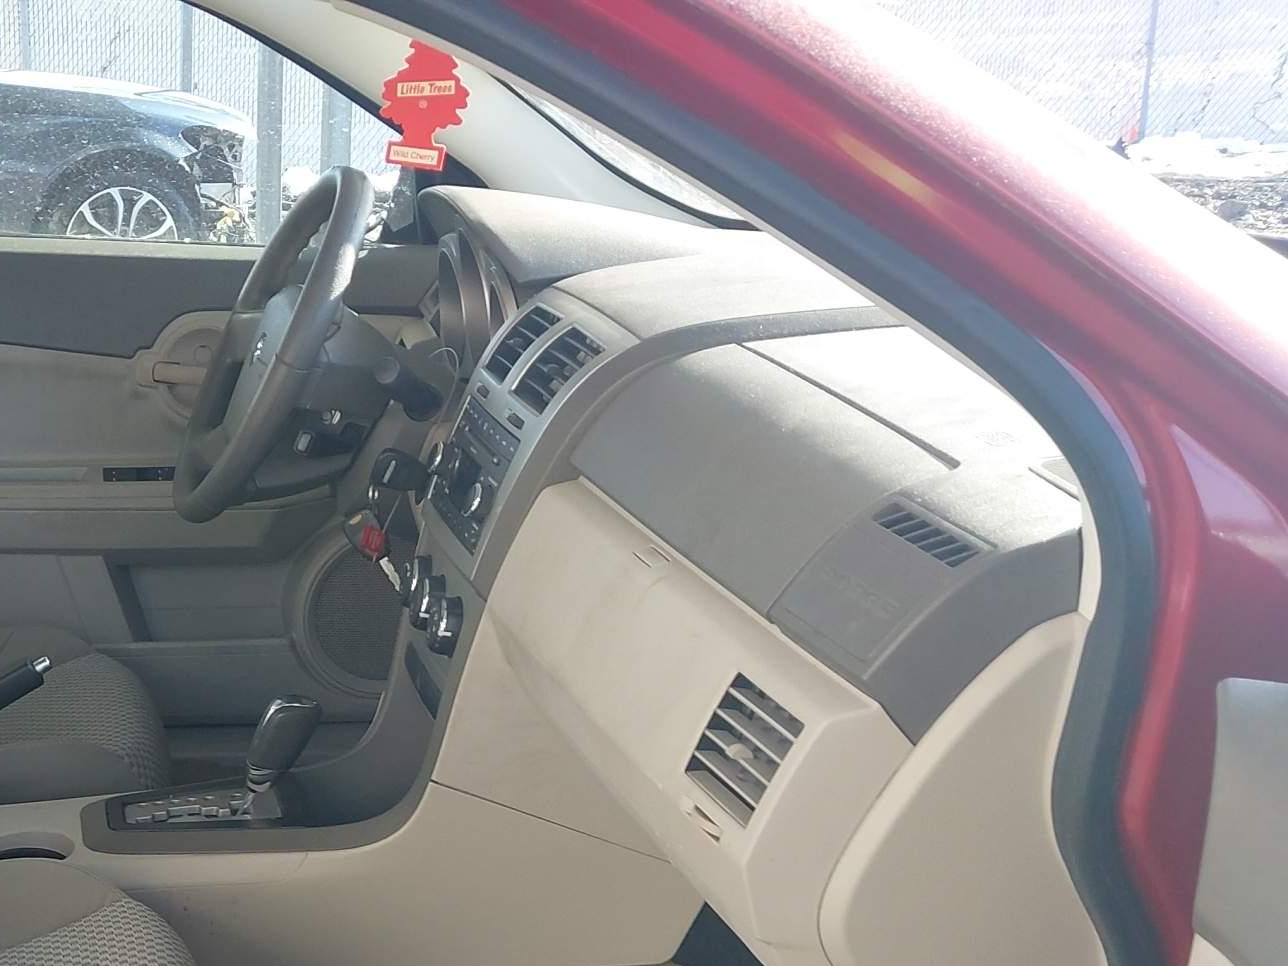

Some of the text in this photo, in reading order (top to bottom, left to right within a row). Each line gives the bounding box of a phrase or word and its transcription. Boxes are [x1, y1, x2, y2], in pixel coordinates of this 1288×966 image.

[400, 82, 453, 95] Little Trees
[393, 149, 435, 163] Wild Cherry
